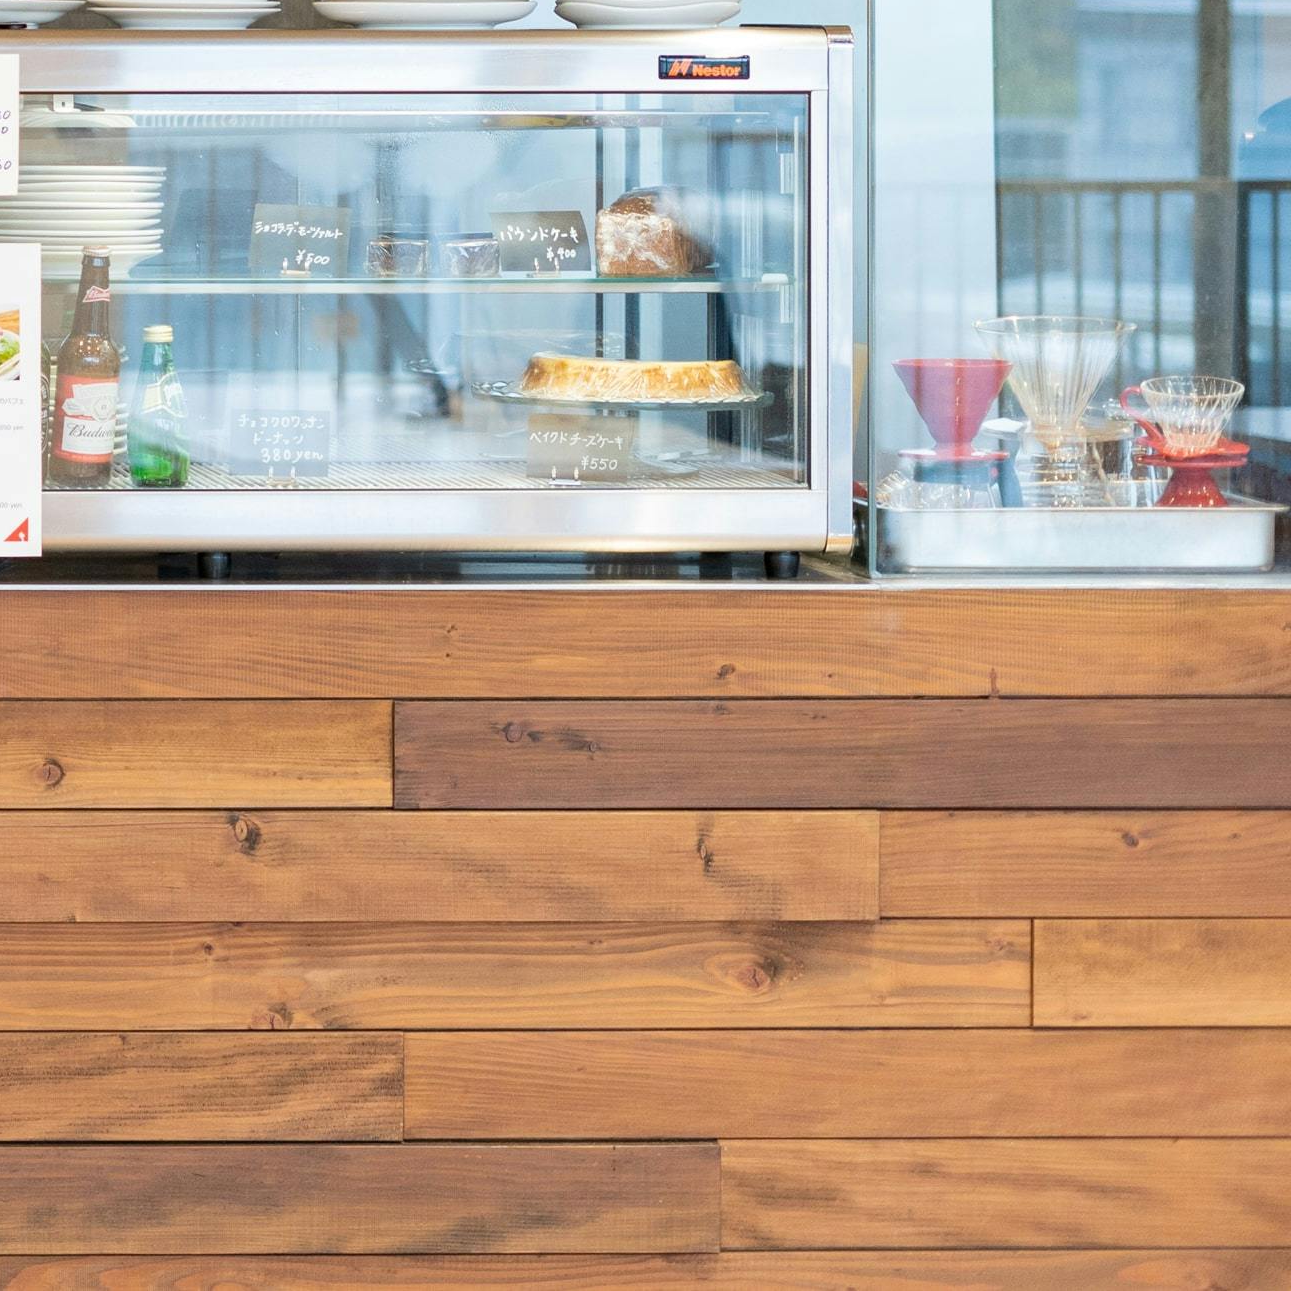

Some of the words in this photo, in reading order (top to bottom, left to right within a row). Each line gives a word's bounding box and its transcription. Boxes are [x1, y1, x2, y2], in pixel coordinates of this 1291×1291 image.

[692, 64, 742, 77] Nestor
[500, 224, 579, 243] パウンドケーキ
[295, 249, 330, 266] ¥500
[546, 246, 577, 262] ¥400
[529, 431, 624, 451] ベイクドチーズケーキ
[260, 447, 292, 464] 380
[581, 455, 618, 471] ¥550
